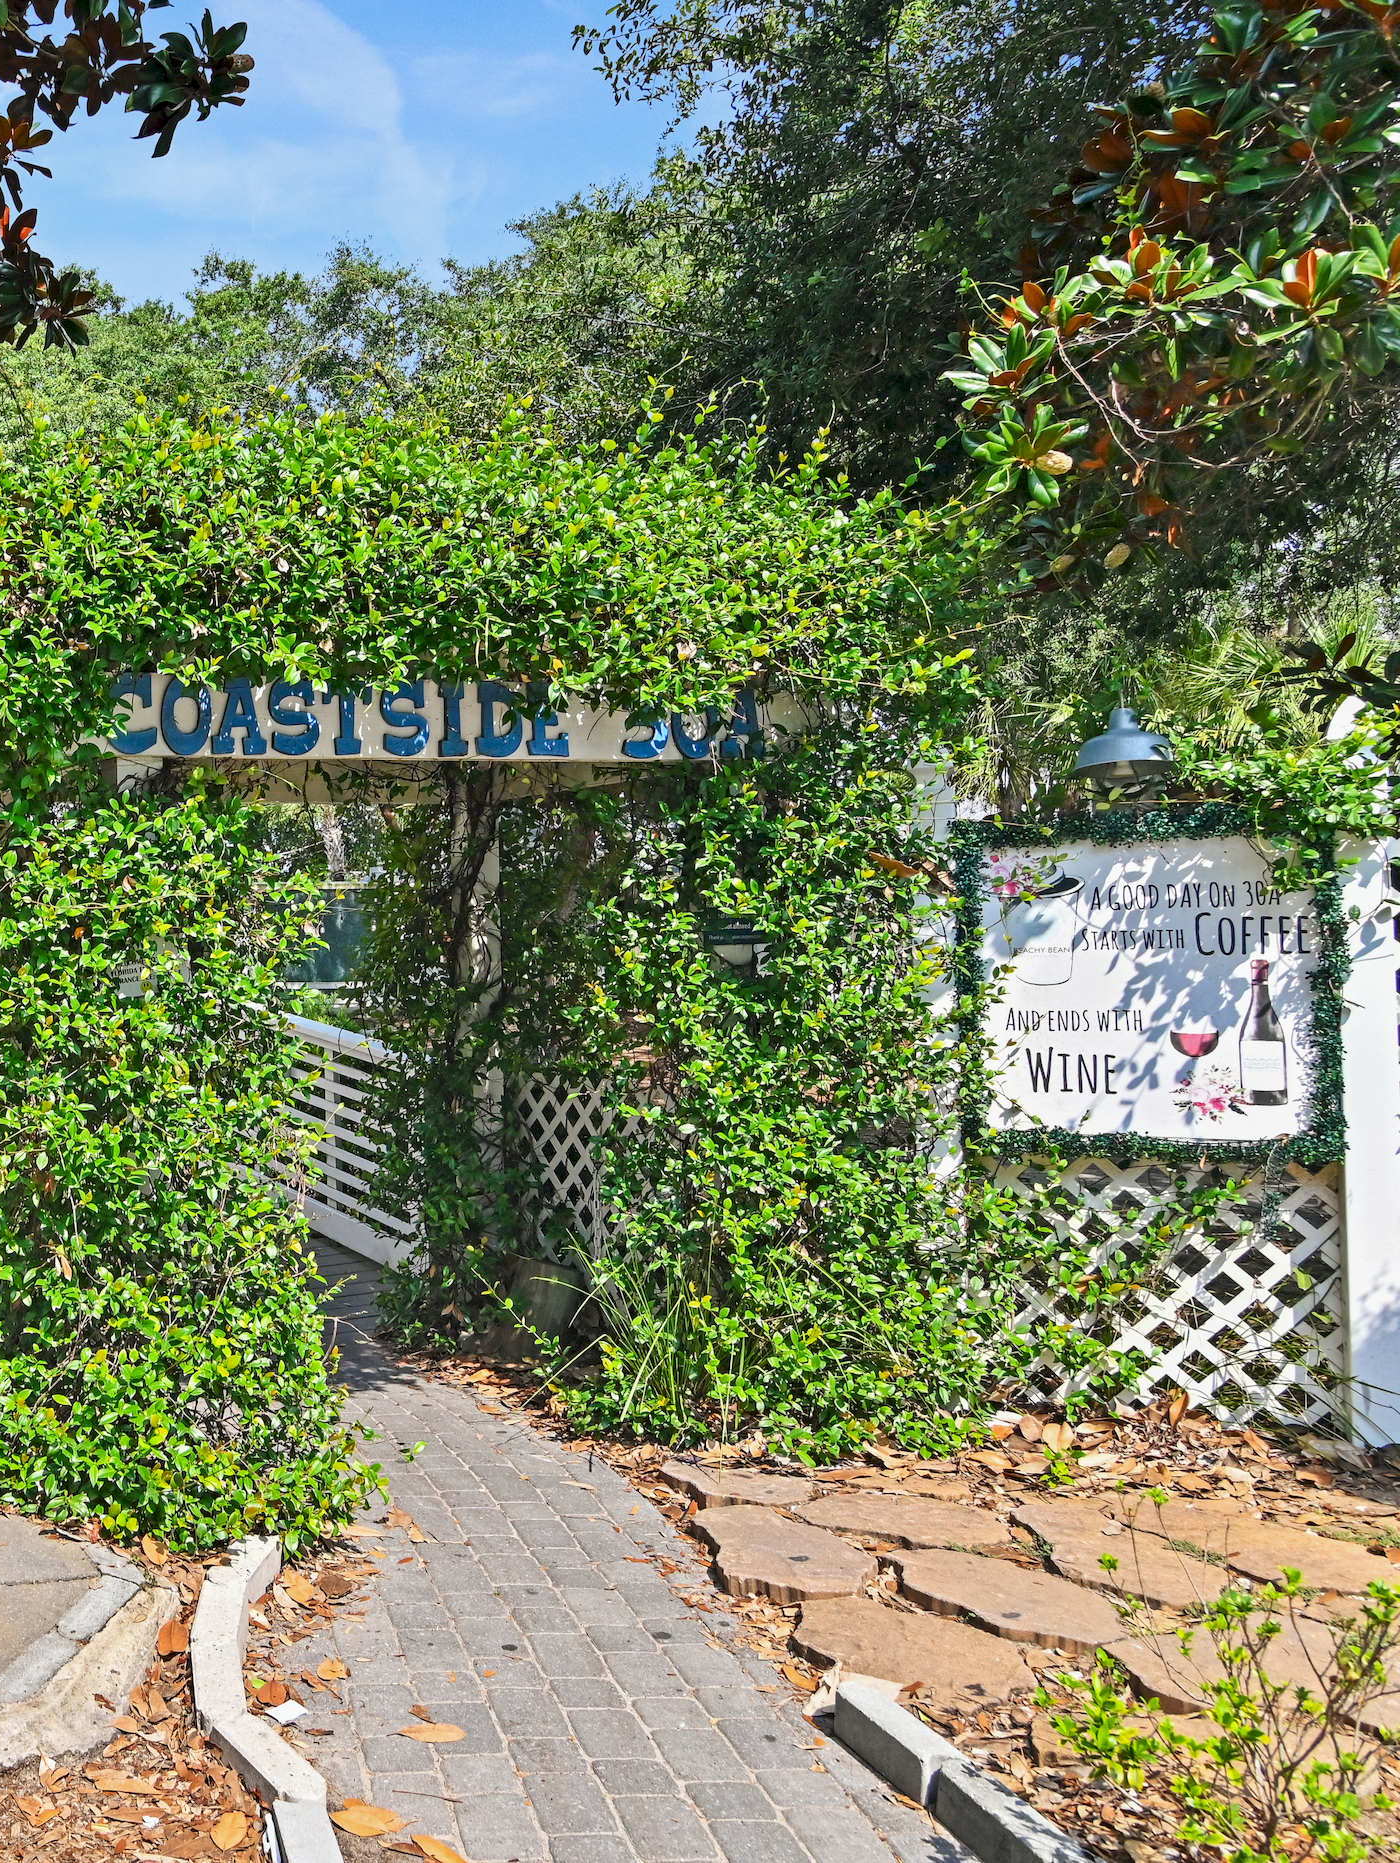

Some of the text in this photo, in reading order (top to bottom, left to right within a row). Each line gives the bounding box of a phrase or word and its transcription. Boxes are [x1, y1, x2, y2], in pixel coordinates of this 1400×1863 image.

[107, 671, 570, 758] COASTSIDE
[1090, 880, 1281, 911] A GOOD DAY ON 30A
[1081, 911, 1312, 956] STARTS WITH COFFEE
[1005, 1007, 1143, 1032] AND ENDS WITH
[1025, 1046, 1118, 1095] WINE
